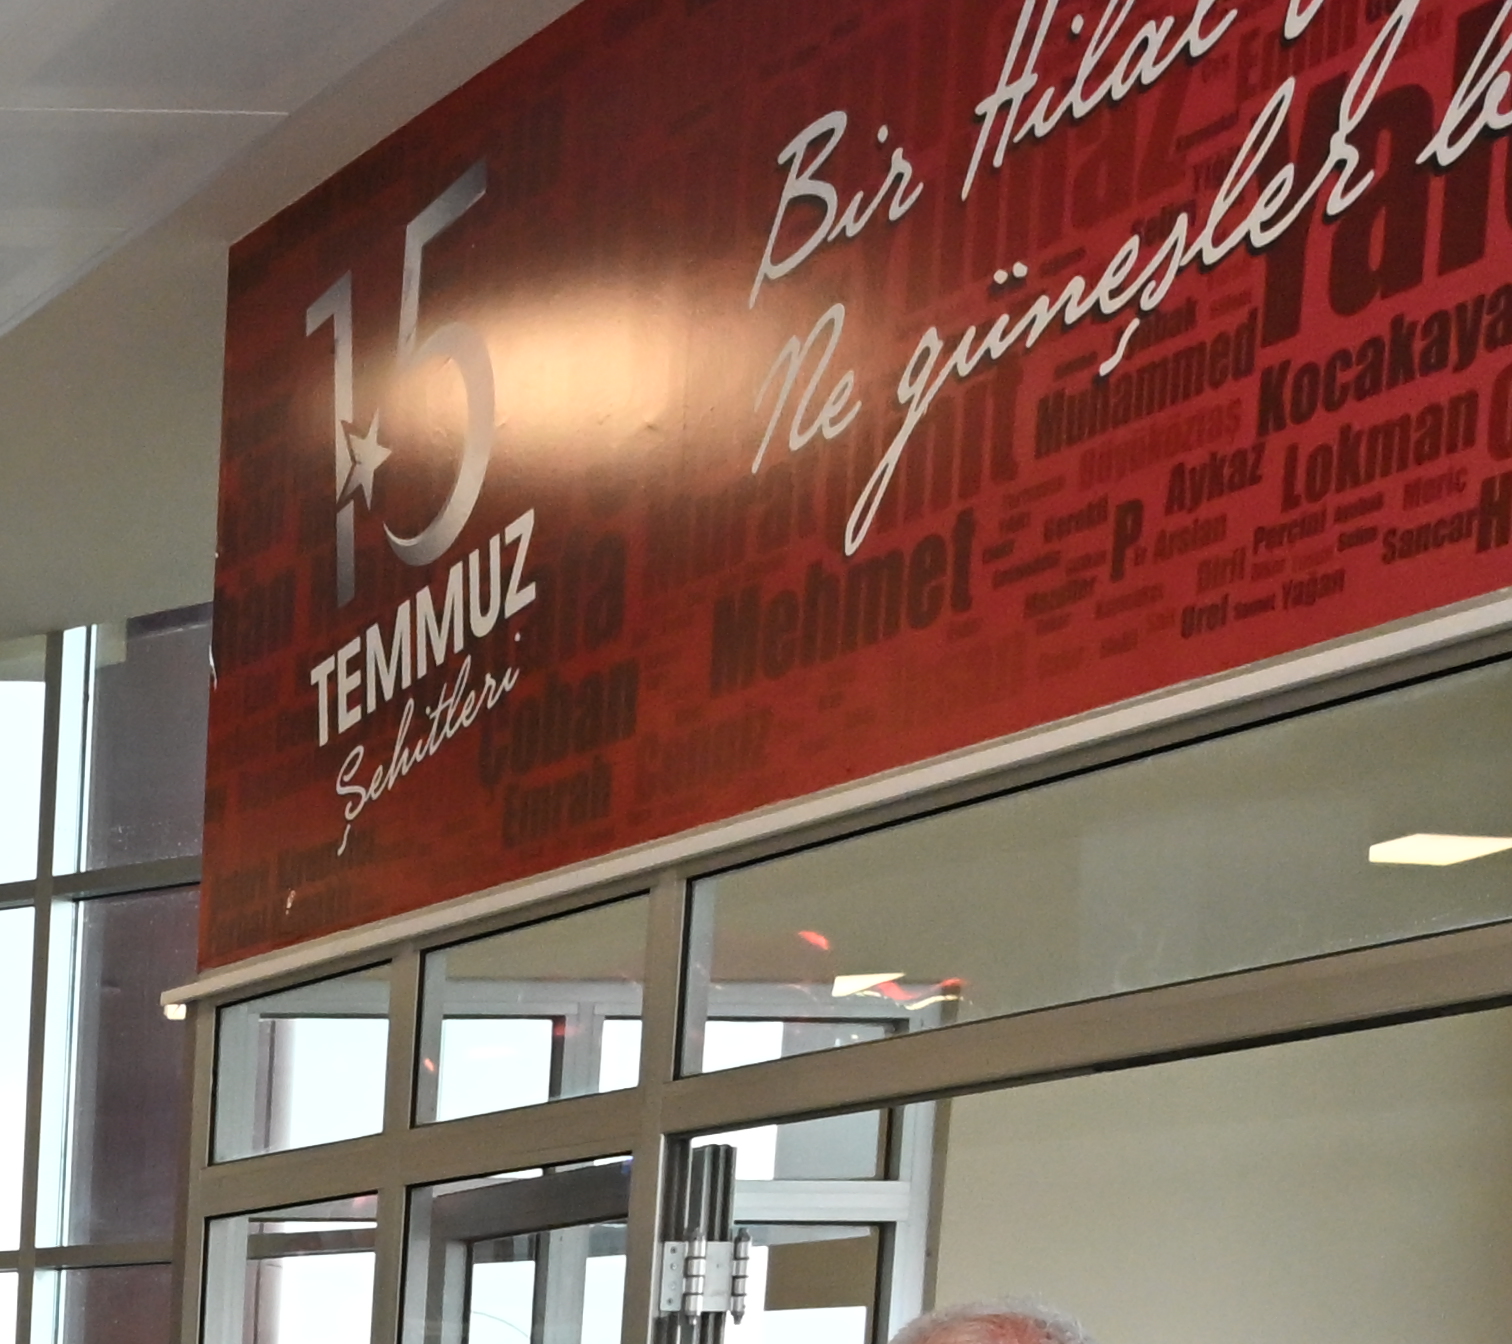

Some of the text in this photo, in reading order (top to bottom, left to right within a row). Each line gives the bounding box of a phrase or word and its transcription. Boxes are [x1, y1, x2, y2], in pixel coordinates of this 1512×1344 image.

[751, 112, 923, 309] Bir
[751, 304, 861, 473] Ne
[1280, 388, 1480, 514] Lokman
[310, 509, 536, 746] TEMMUZ
[336, 632, 521, 856] Şehitleri
